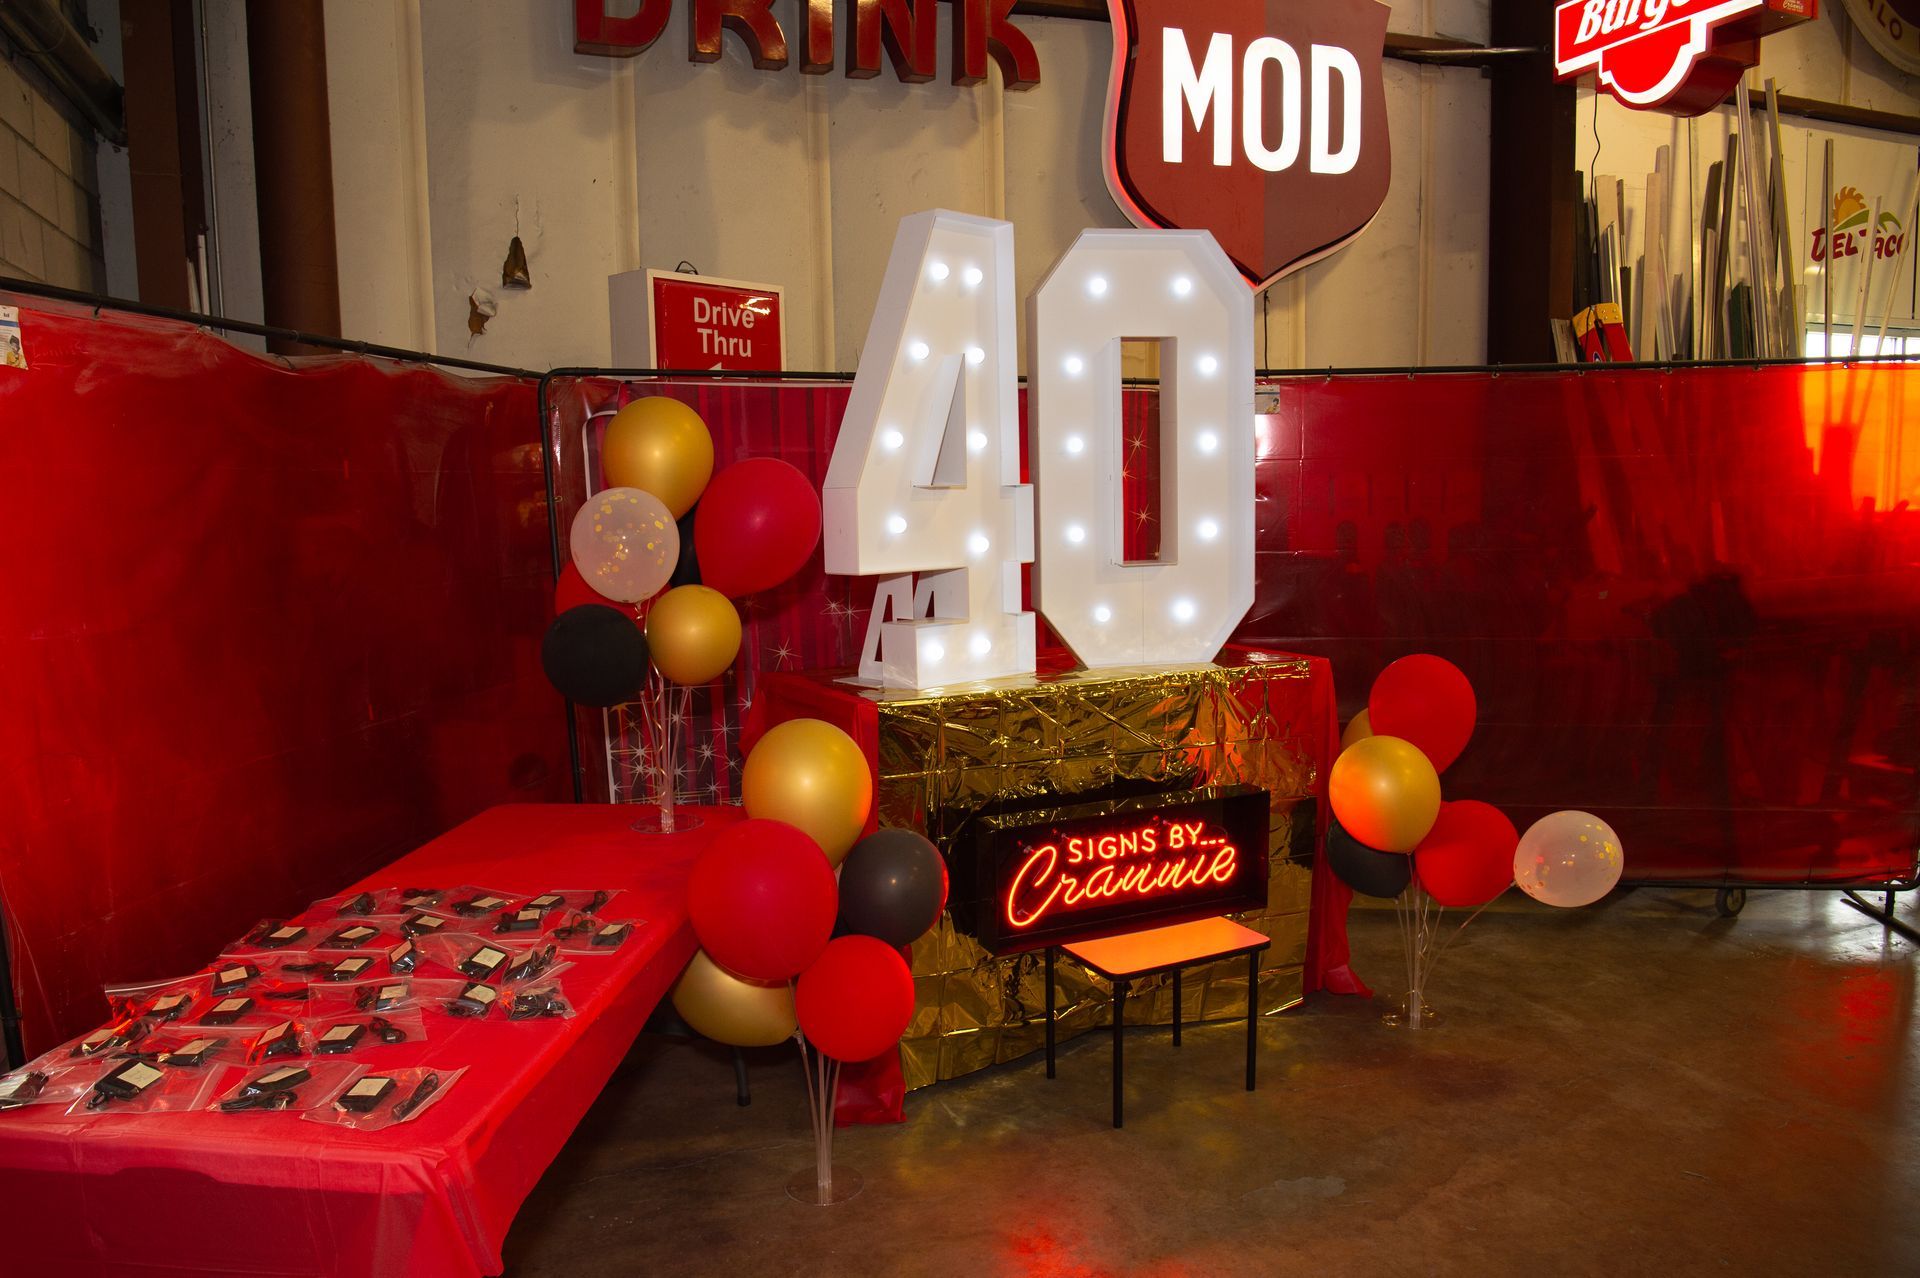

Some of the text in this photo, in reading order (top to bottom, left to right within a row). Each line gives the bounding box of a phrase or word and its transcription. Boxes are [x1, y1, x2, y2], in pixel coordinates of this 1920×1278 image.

[1162, 26, 1362, 175] MOD
[693, 296, 755, 329] Drive
[696, 327, 752, 358] Thru
[823, 208, 1256, 690] 40
[1067, 828, 1157, 863] SIGNS
